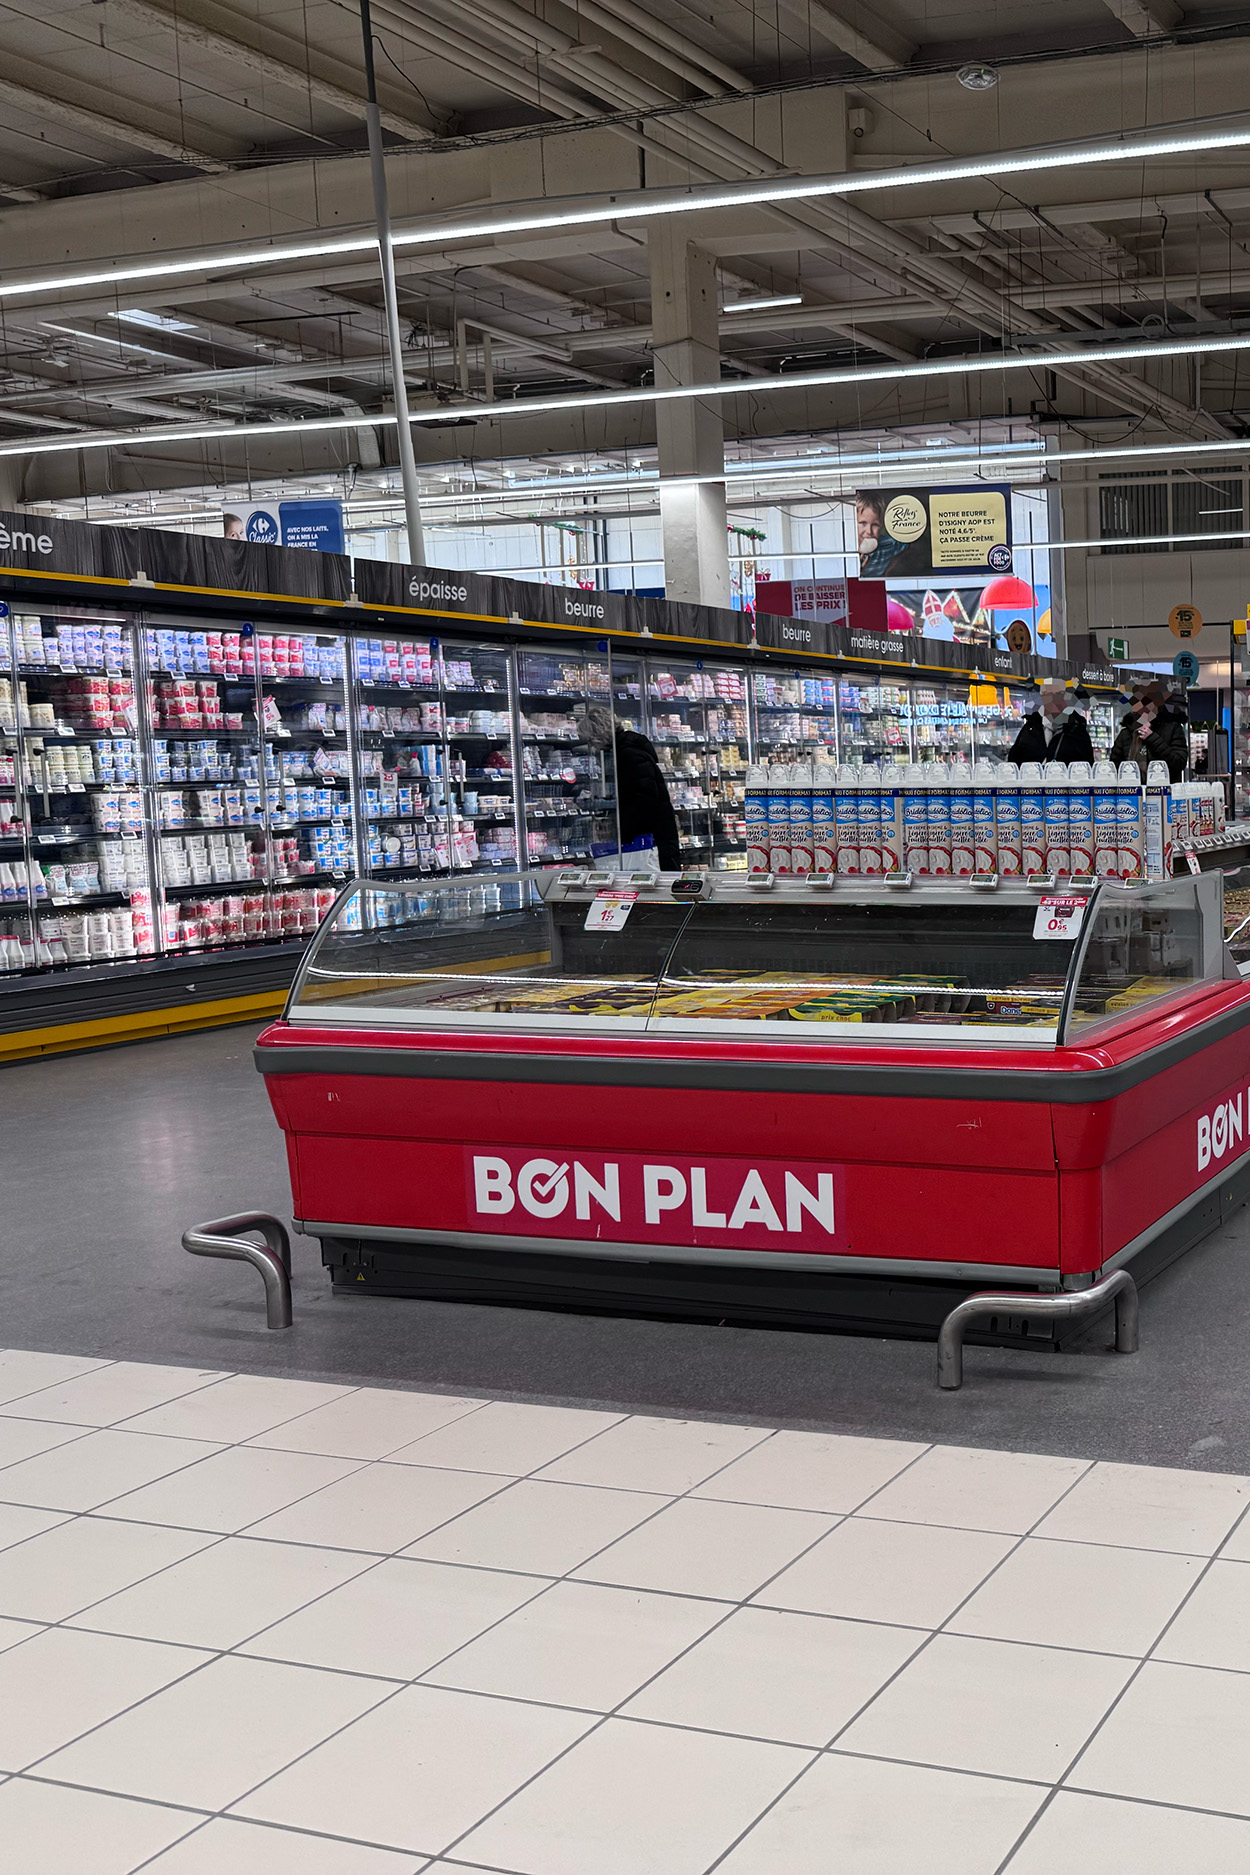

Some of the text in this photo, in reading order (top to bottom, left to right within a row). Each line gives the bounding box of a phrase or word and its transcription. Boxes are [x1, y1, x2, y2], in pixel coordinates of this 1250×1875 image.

[971, 534, 994, 542] CRÈME
[408, 575, 468, 602] épaisse
[795, 591, 845, 601] DE BAISSER
[565, 598, 605, 620] beurre
[795, 601, 814, 611] LES
[816, 600, 841, 609] PRIX
[782, 623, 811, 643] beurre
[851, 634, 904, 654] matière grasse
[994, 656, 1013, 669] enfant
[1197, 1091, 1243, 1172] BON
[473, 1155, 835, 1235] BON PLAN
